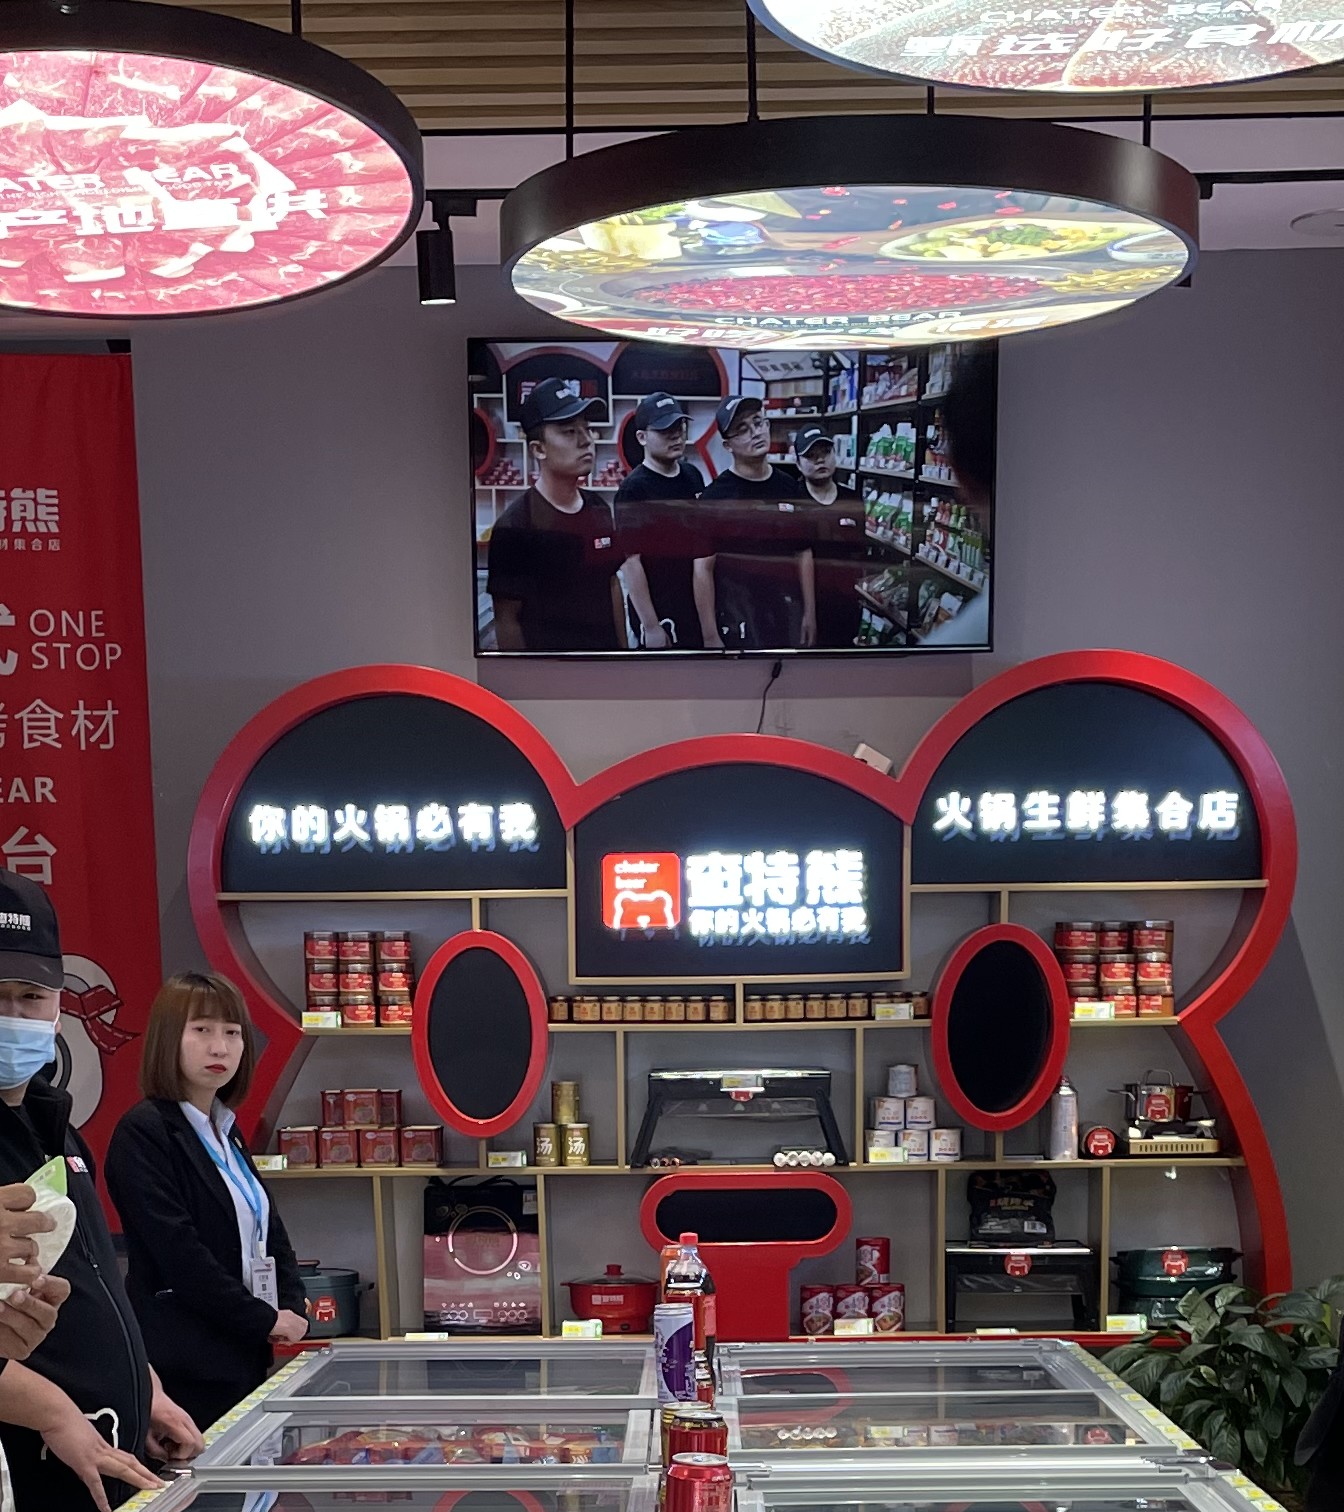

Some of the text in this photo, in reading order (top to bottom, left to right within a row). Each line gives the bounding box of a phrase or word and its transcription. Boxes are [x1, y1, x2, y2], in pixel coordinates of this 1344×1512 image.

[980, 5, 1145, 23] CHATER
[29, 609, 105, 637] ONE
[31, 642, 122, 671] STOP
[249, 802, 536, 843] 你的火锅必有我
[934, 790, 1239, 832] 火锅生鲜集合店
[686, 849, 865, 906] 查特熊
[688, 907, 868, 936] 你的火锅必有我
[567, 1136, 586, 1155] 汤
